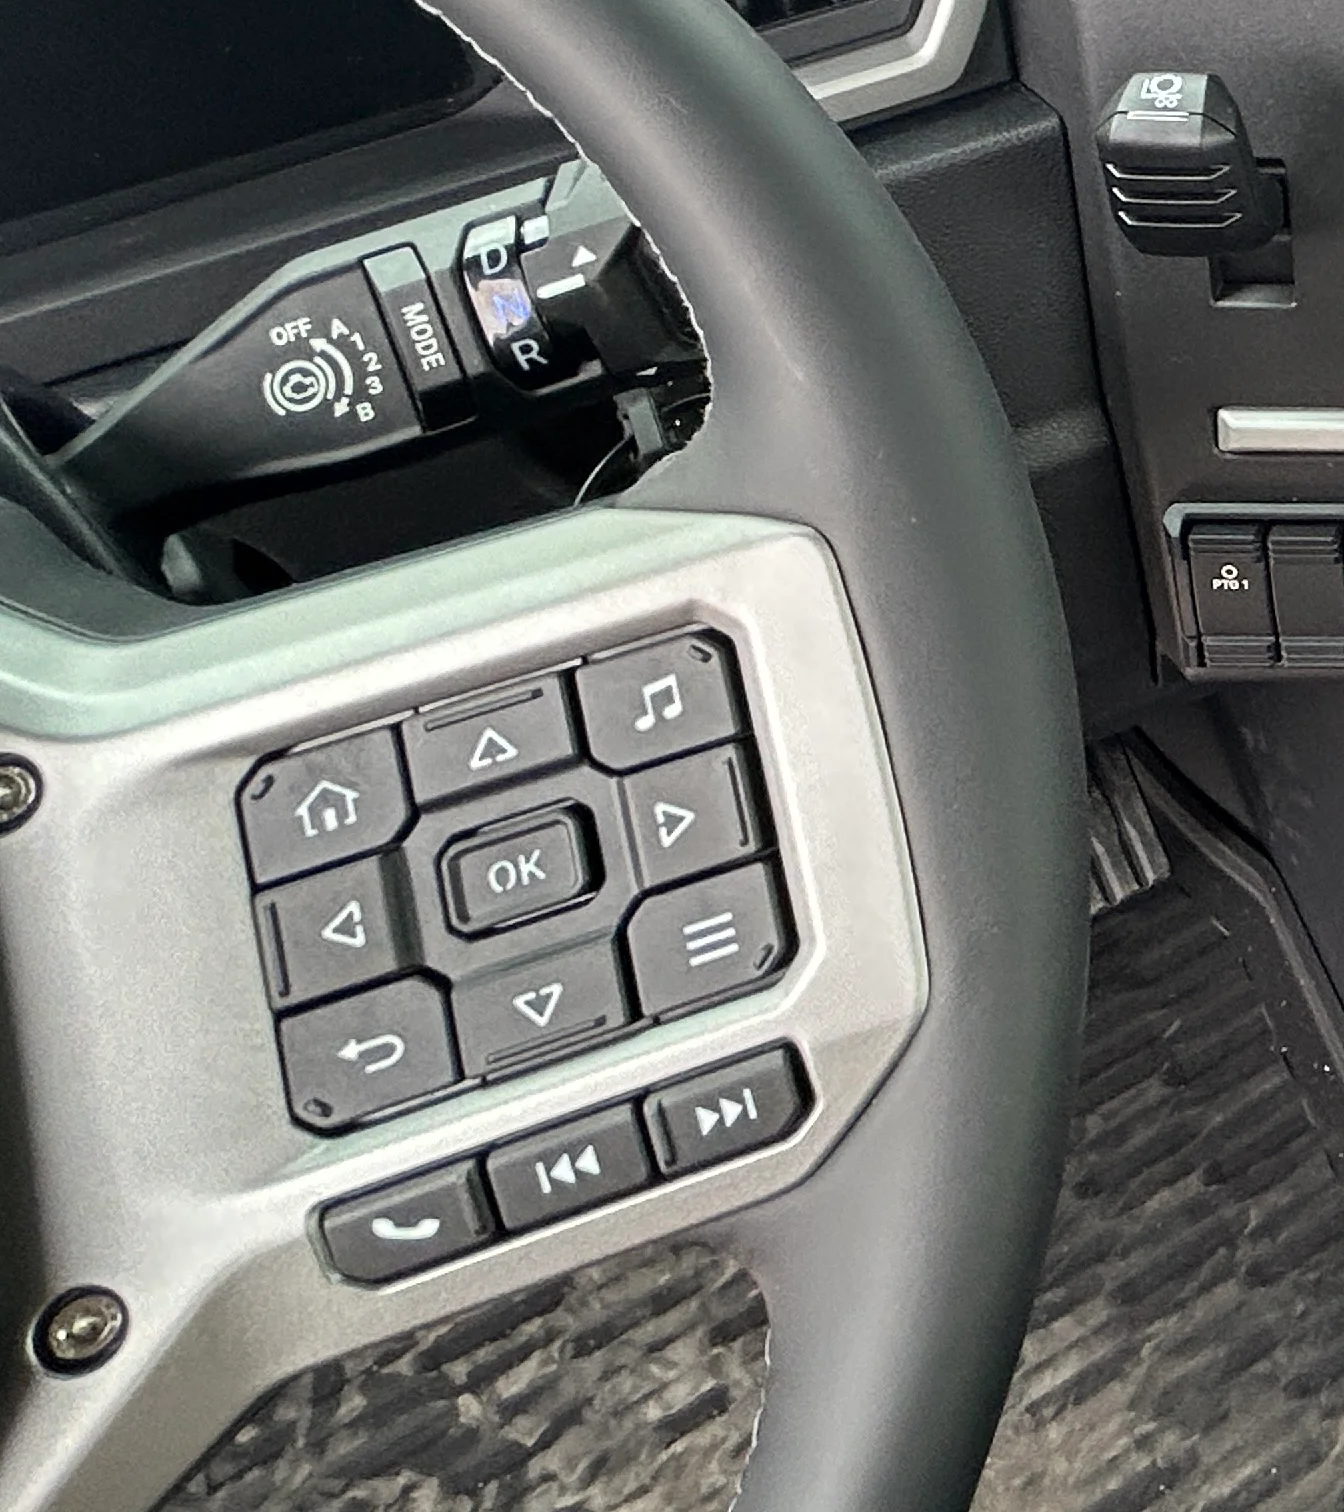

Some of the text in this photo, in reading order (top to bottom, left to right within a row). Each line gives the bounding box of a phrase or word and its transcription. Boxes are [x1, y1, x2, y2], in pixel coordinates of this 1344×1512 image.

[401, 302, 446, 372] MODE
[480, 243, 548, 371] D N R
[269, 317, 383, 422] OFF A 1 2 3 B
[1212, 578, 1249, 590] PTO 1
[488, 848, 547, 894] OK
